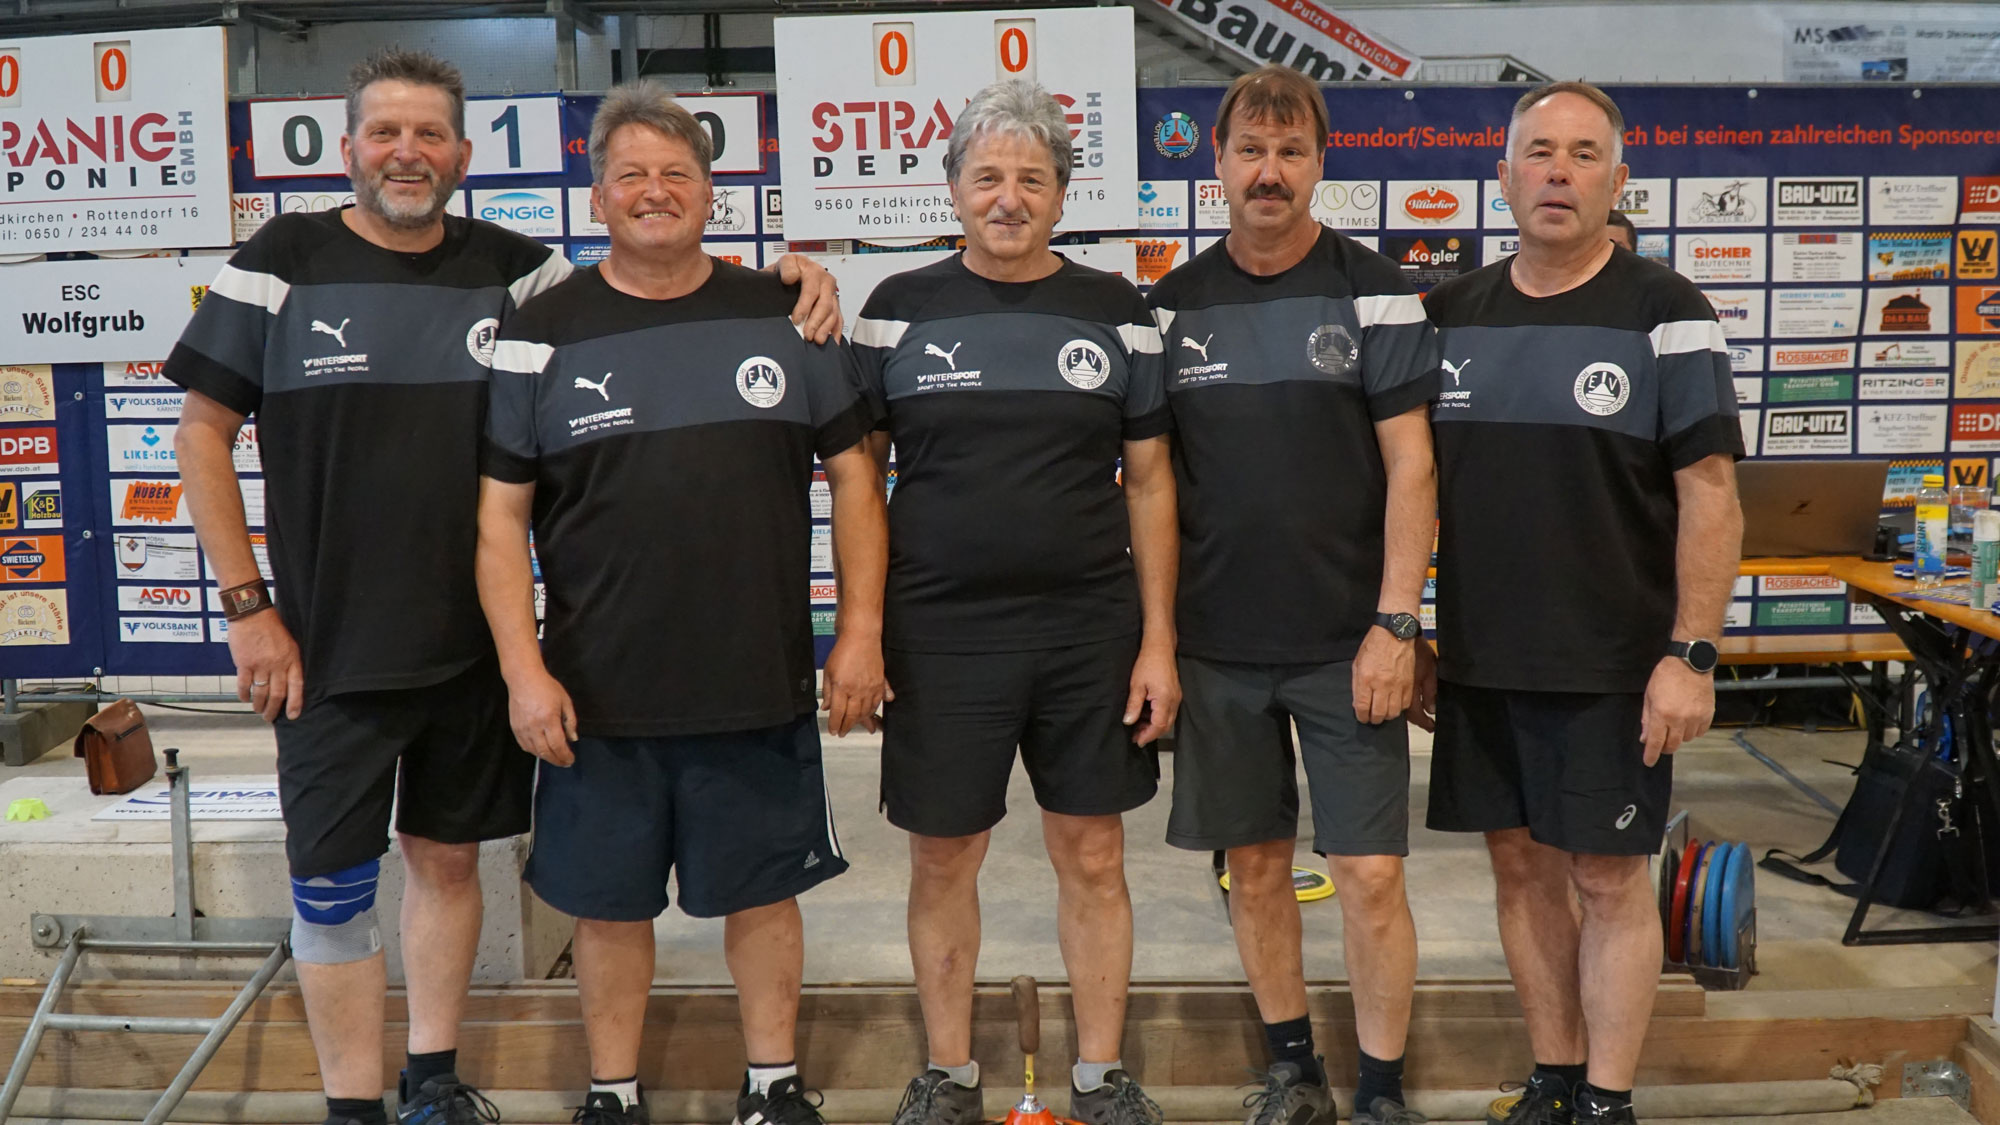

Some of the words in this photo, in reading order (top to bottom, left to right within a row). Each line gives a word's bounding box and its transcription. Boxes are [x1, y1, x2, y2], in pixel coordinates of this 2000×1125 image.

[1292, 3, 1330, 29] Putze
[1344, 33, 1400, 71] Estriche
[1794, 28, 1824, 43] MS
[880, 31, 908, 76] 0
[1000, 28, 1029, 72] 0
[100, 48, 127, 92] 0
[491, 105, 521, 168] 1
[1086, 92, 1104, 168] GMBH
[1655, 125, 1688, 145] bei
[1694, 125, 1763, 145] seinen
[1770, 124, 1892, 145] zahlreichen
[178, 111, 197, 185] GMBH
[283, 115, 323, 166] 0
[815, 199, 854, 211] 9560
[862, 195, 951, 209] Feldkirche
[1087, 190, 1105, 201] 16
[1781, 185, 1857, 204] BAU-UITZ
[87, 208, 173, 221] Rottendorf
[181, 206, 199, 218] 16
[859, 213, 911, 225] Mobil:
[919, 211, 957, 223] 0650
[1340, 217, 1378, 226] TIMES
[25, 229, 60, 240] 0650
[68, 227, 73, 238] /
[81, 226, 107, 237] 234
[116, 225, 132, 236] 44
[141, 224, 158, 235] 08
[1694, 247, 1752, 258] SICHER
[61, 284, 100, 301] ESC
[22, 310, 145, 338] Wolfgrub
[313, 354, 368, 367] INTERSPORT
[1070, 351, 1078, 365] E
[1089, 352, 1098, 366] V
[126, 363, 165, 379] ASV
[747, 370, 756, 384] E
[765, 369, 774, 383] V
[927, 371, 981, 383] INTERSPORT
[1588, 375, 1598, 388] E
[1609, 378, 1618, 390] V
[1863, 378, 1946, 387] RITZINGER
[579, 407, 632, 425] INTERSPORT
[1772, 414, 1844, 434] BAU-UITZ
[1, 436, 50, 455] DPB
[133, 486, 172, 498] HUBER
[31, 497, 56, 512] K&B
[2, 555, 43, 564] SWIETELSKY
